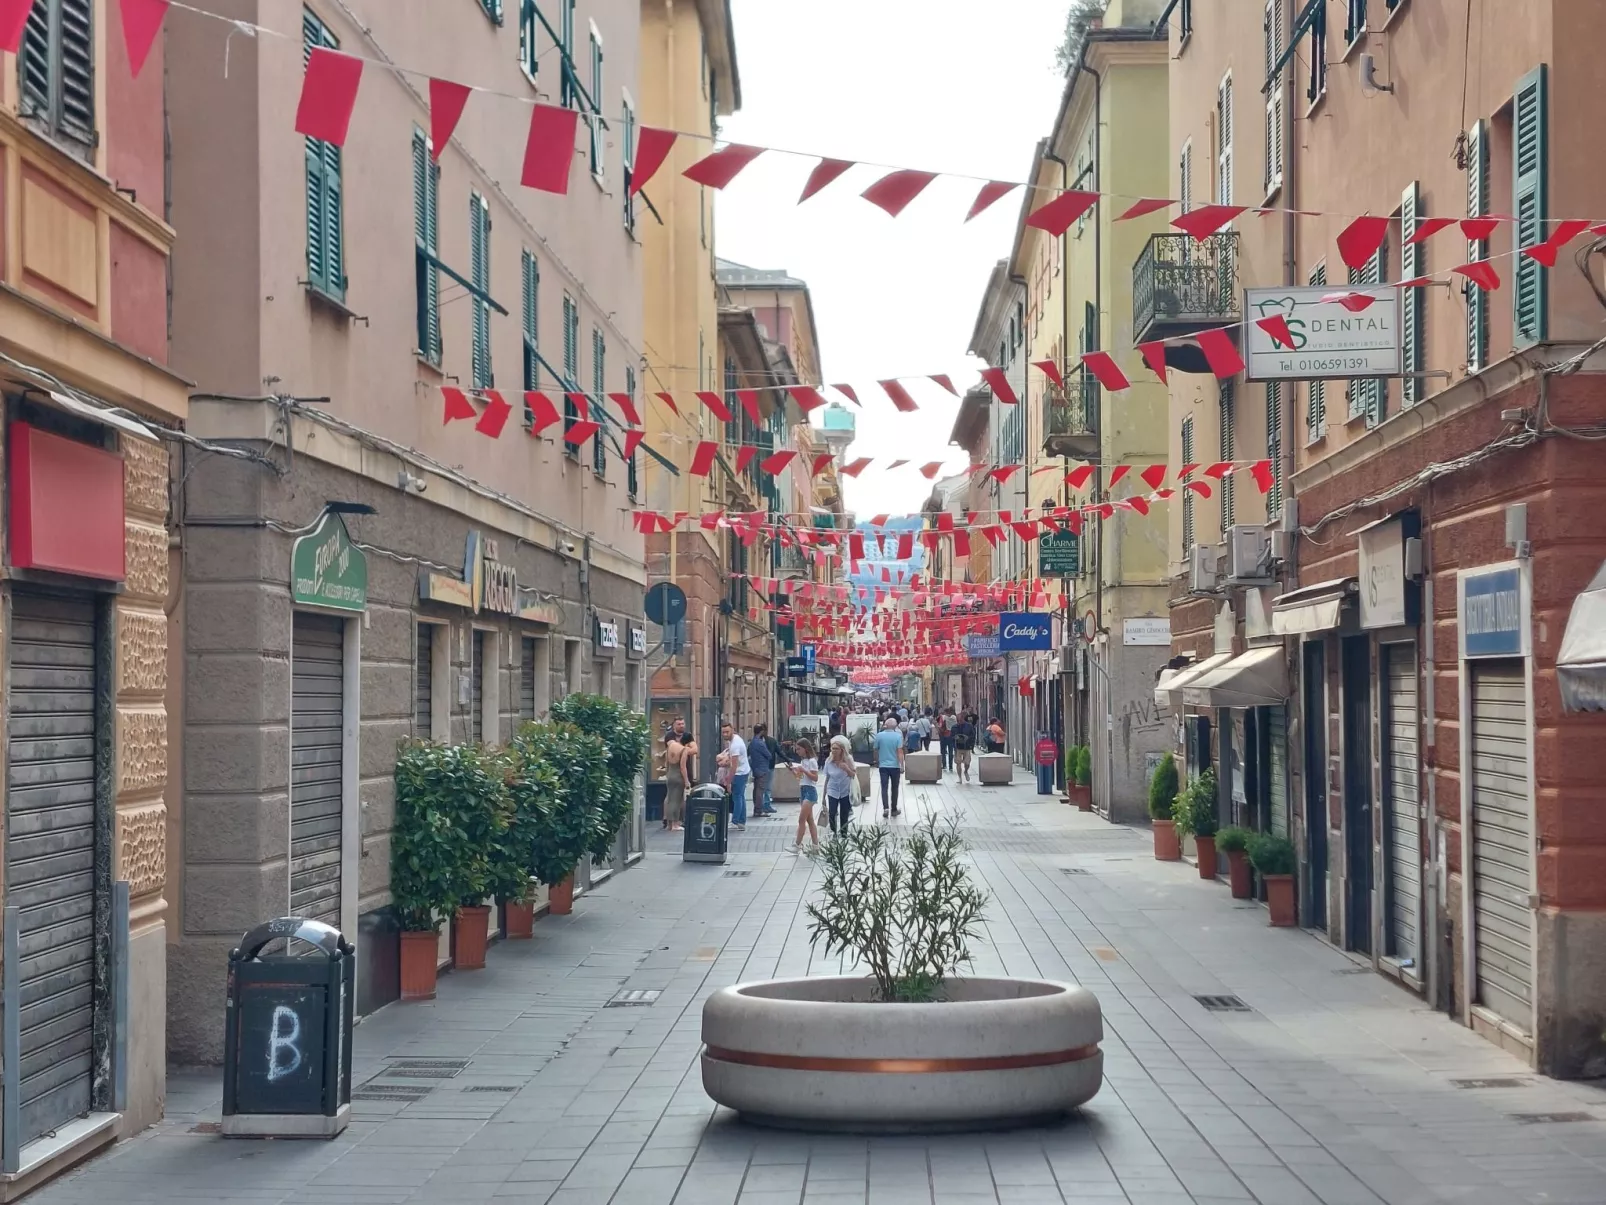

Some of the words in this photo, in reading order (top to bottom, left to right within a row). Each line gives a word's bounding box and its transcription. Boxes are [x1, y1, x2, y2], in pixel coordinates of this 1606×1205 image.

[1311, 317, 1389, 333] DENTAL
[1299, 357, 1369, 370] 0106591391
[484, 560, 517, 615] REGGIO
[268, 1006, 301, 1080] B
